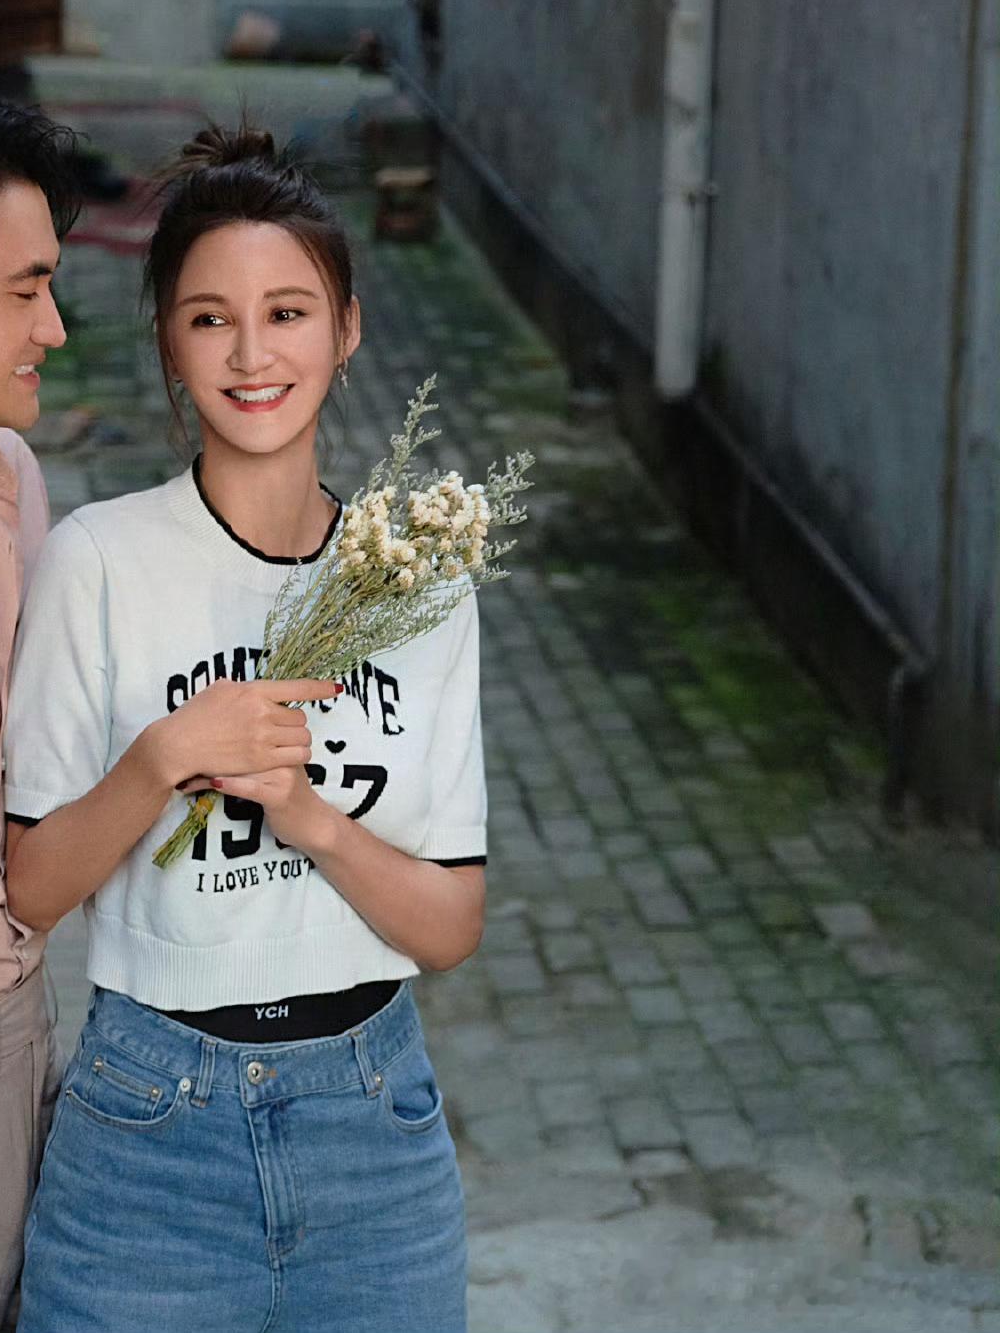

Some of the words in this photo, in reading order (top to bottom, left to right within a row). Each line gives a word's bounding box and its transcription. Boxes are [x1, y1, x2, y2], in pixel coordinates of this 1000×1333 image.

[196, 873, 205, 892] I
[213, 866, 259, 893] LOVE
[254, 1004, 289, 1020] YCH
